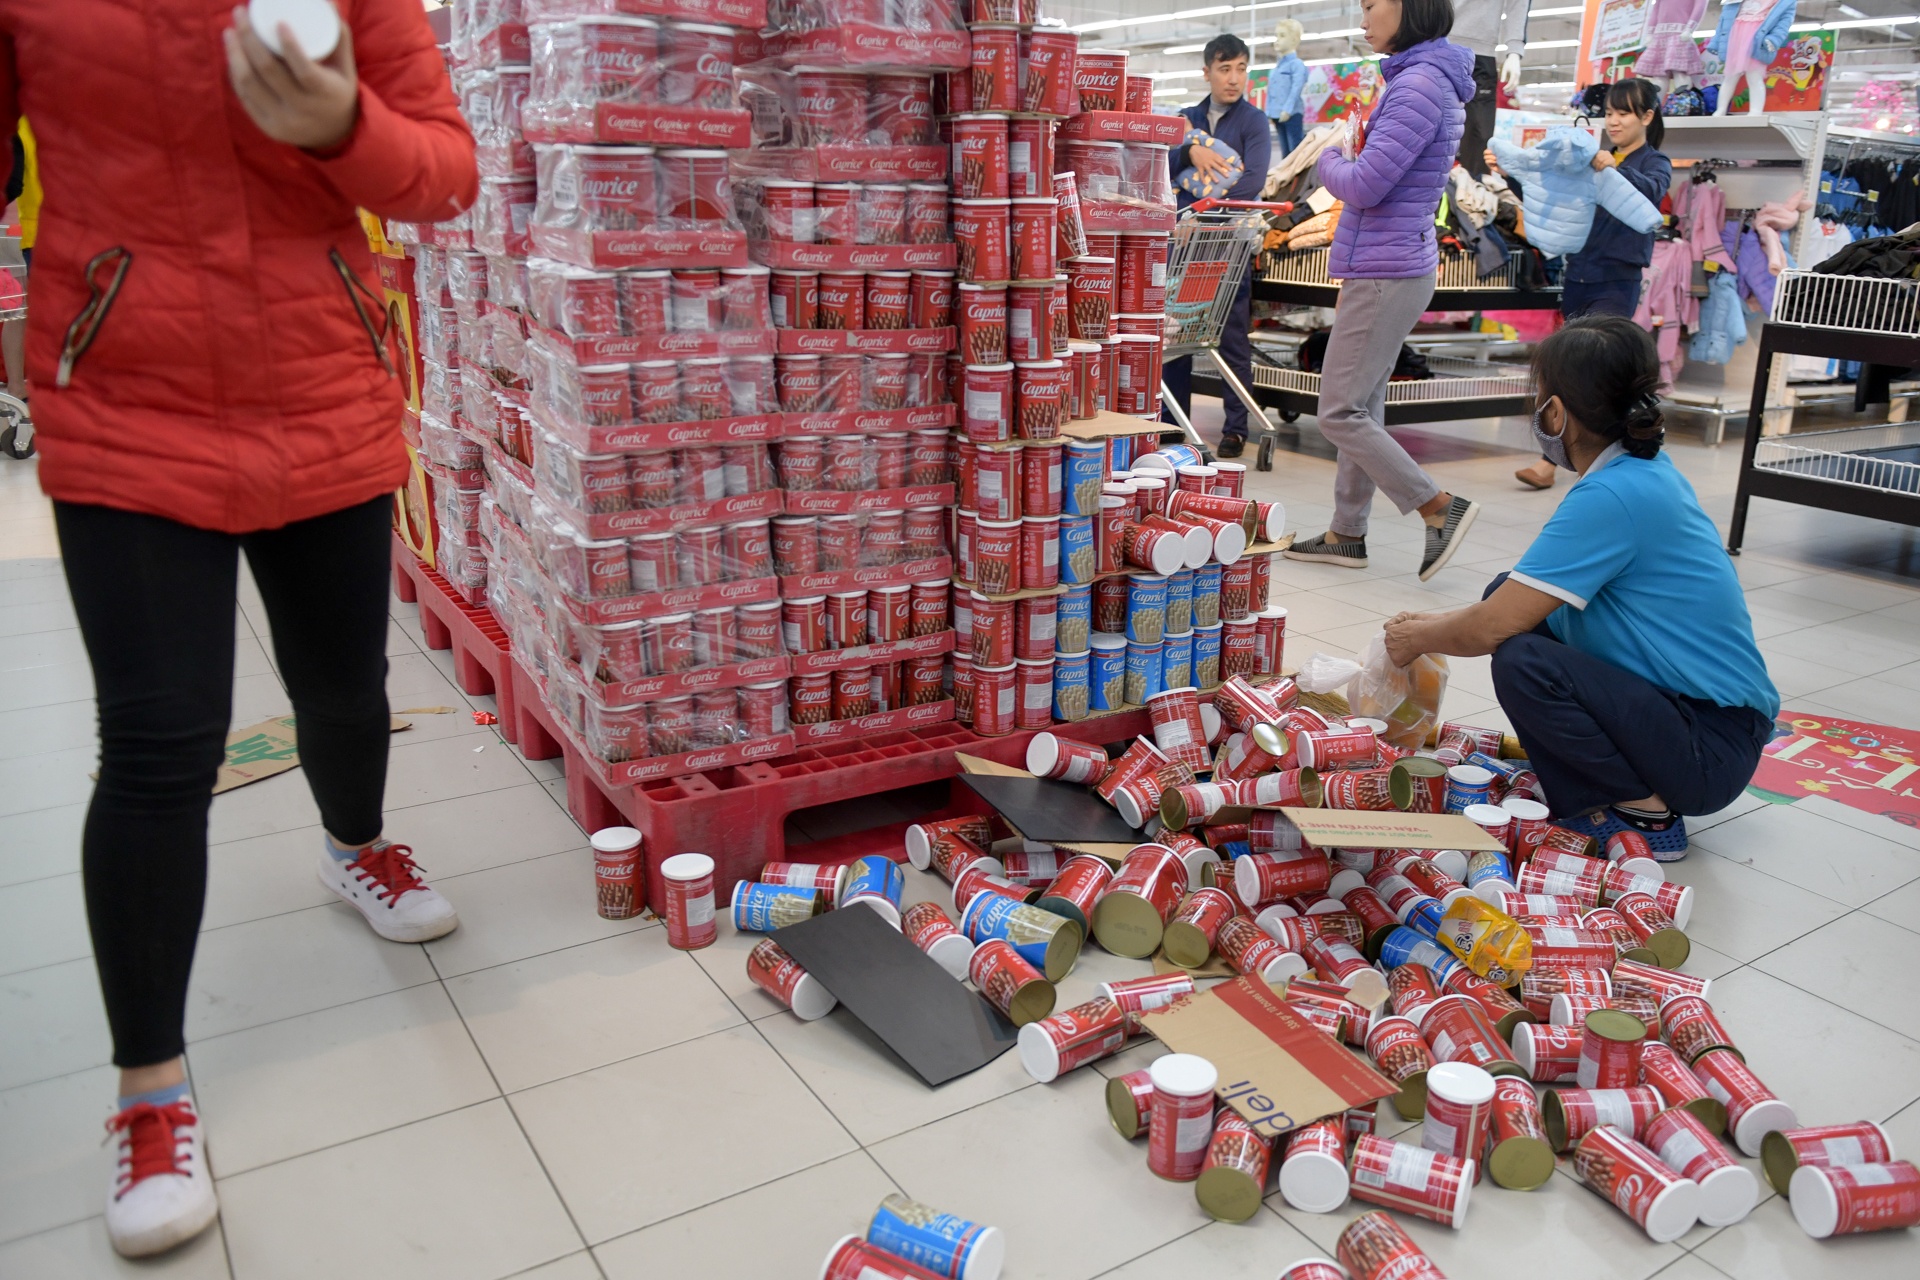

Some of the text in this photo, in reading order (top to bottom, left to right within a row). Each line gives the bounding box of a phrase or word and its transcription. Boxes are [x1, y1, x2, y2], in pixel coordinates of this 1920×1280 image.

[717, 1, 752, 16] Caprice
[856, 33, 889, 48] Caprice
[933, 37, 963, 51] Caprice
[1074, 70, 1119, 87] Caprice
[607, 114, 735, 134] Caprice Caprice Caprice
[1101, 119, 1123, 131] Caprice
[1128, 120, 1151, 132] Caprice
[1156, 123, 1178, 136] Caprice
[831, 158, 937, 172] Caprice Caprice Caprice
[1090, 209, 1112, 220] Caprice
[608, 240, 735, 254] Caprice Caprice Caprice
[792, 249, 942, 265] Caprice Caprice Caprice
[594, 339, 639, 354] Caprice
[659, 337, 702, 350] Caprice
[798, 335, 838, 350] Caprice
[907, 333, 943, 348] Caprice
[801, 411, 943, 431] Caprice Caprice Caprice
[606, 421, 768, 446] Caprice Caprice Caprice
[800, 497, 840, 511] Caprice
[905, 491, 942, 504] Caprice
[608, 496, 767, 530] Caprice Caprice Caprice
[801, 561, 938, 588] Caprice Caprice Caprice
[601, 583, 760, 615] Caprice Caprice Caprice
[623, 661, 776, 695] Caprice Caprice Caprice
[860, 715, 895, 728] Caprice
[907, 706, 942, 718] Caprice
[627, 741, 780, 777] Caprice Caprice Caprice
[748, 891, 764, 930] Caprice
[1222, 1080, 1295, 1131] deli
